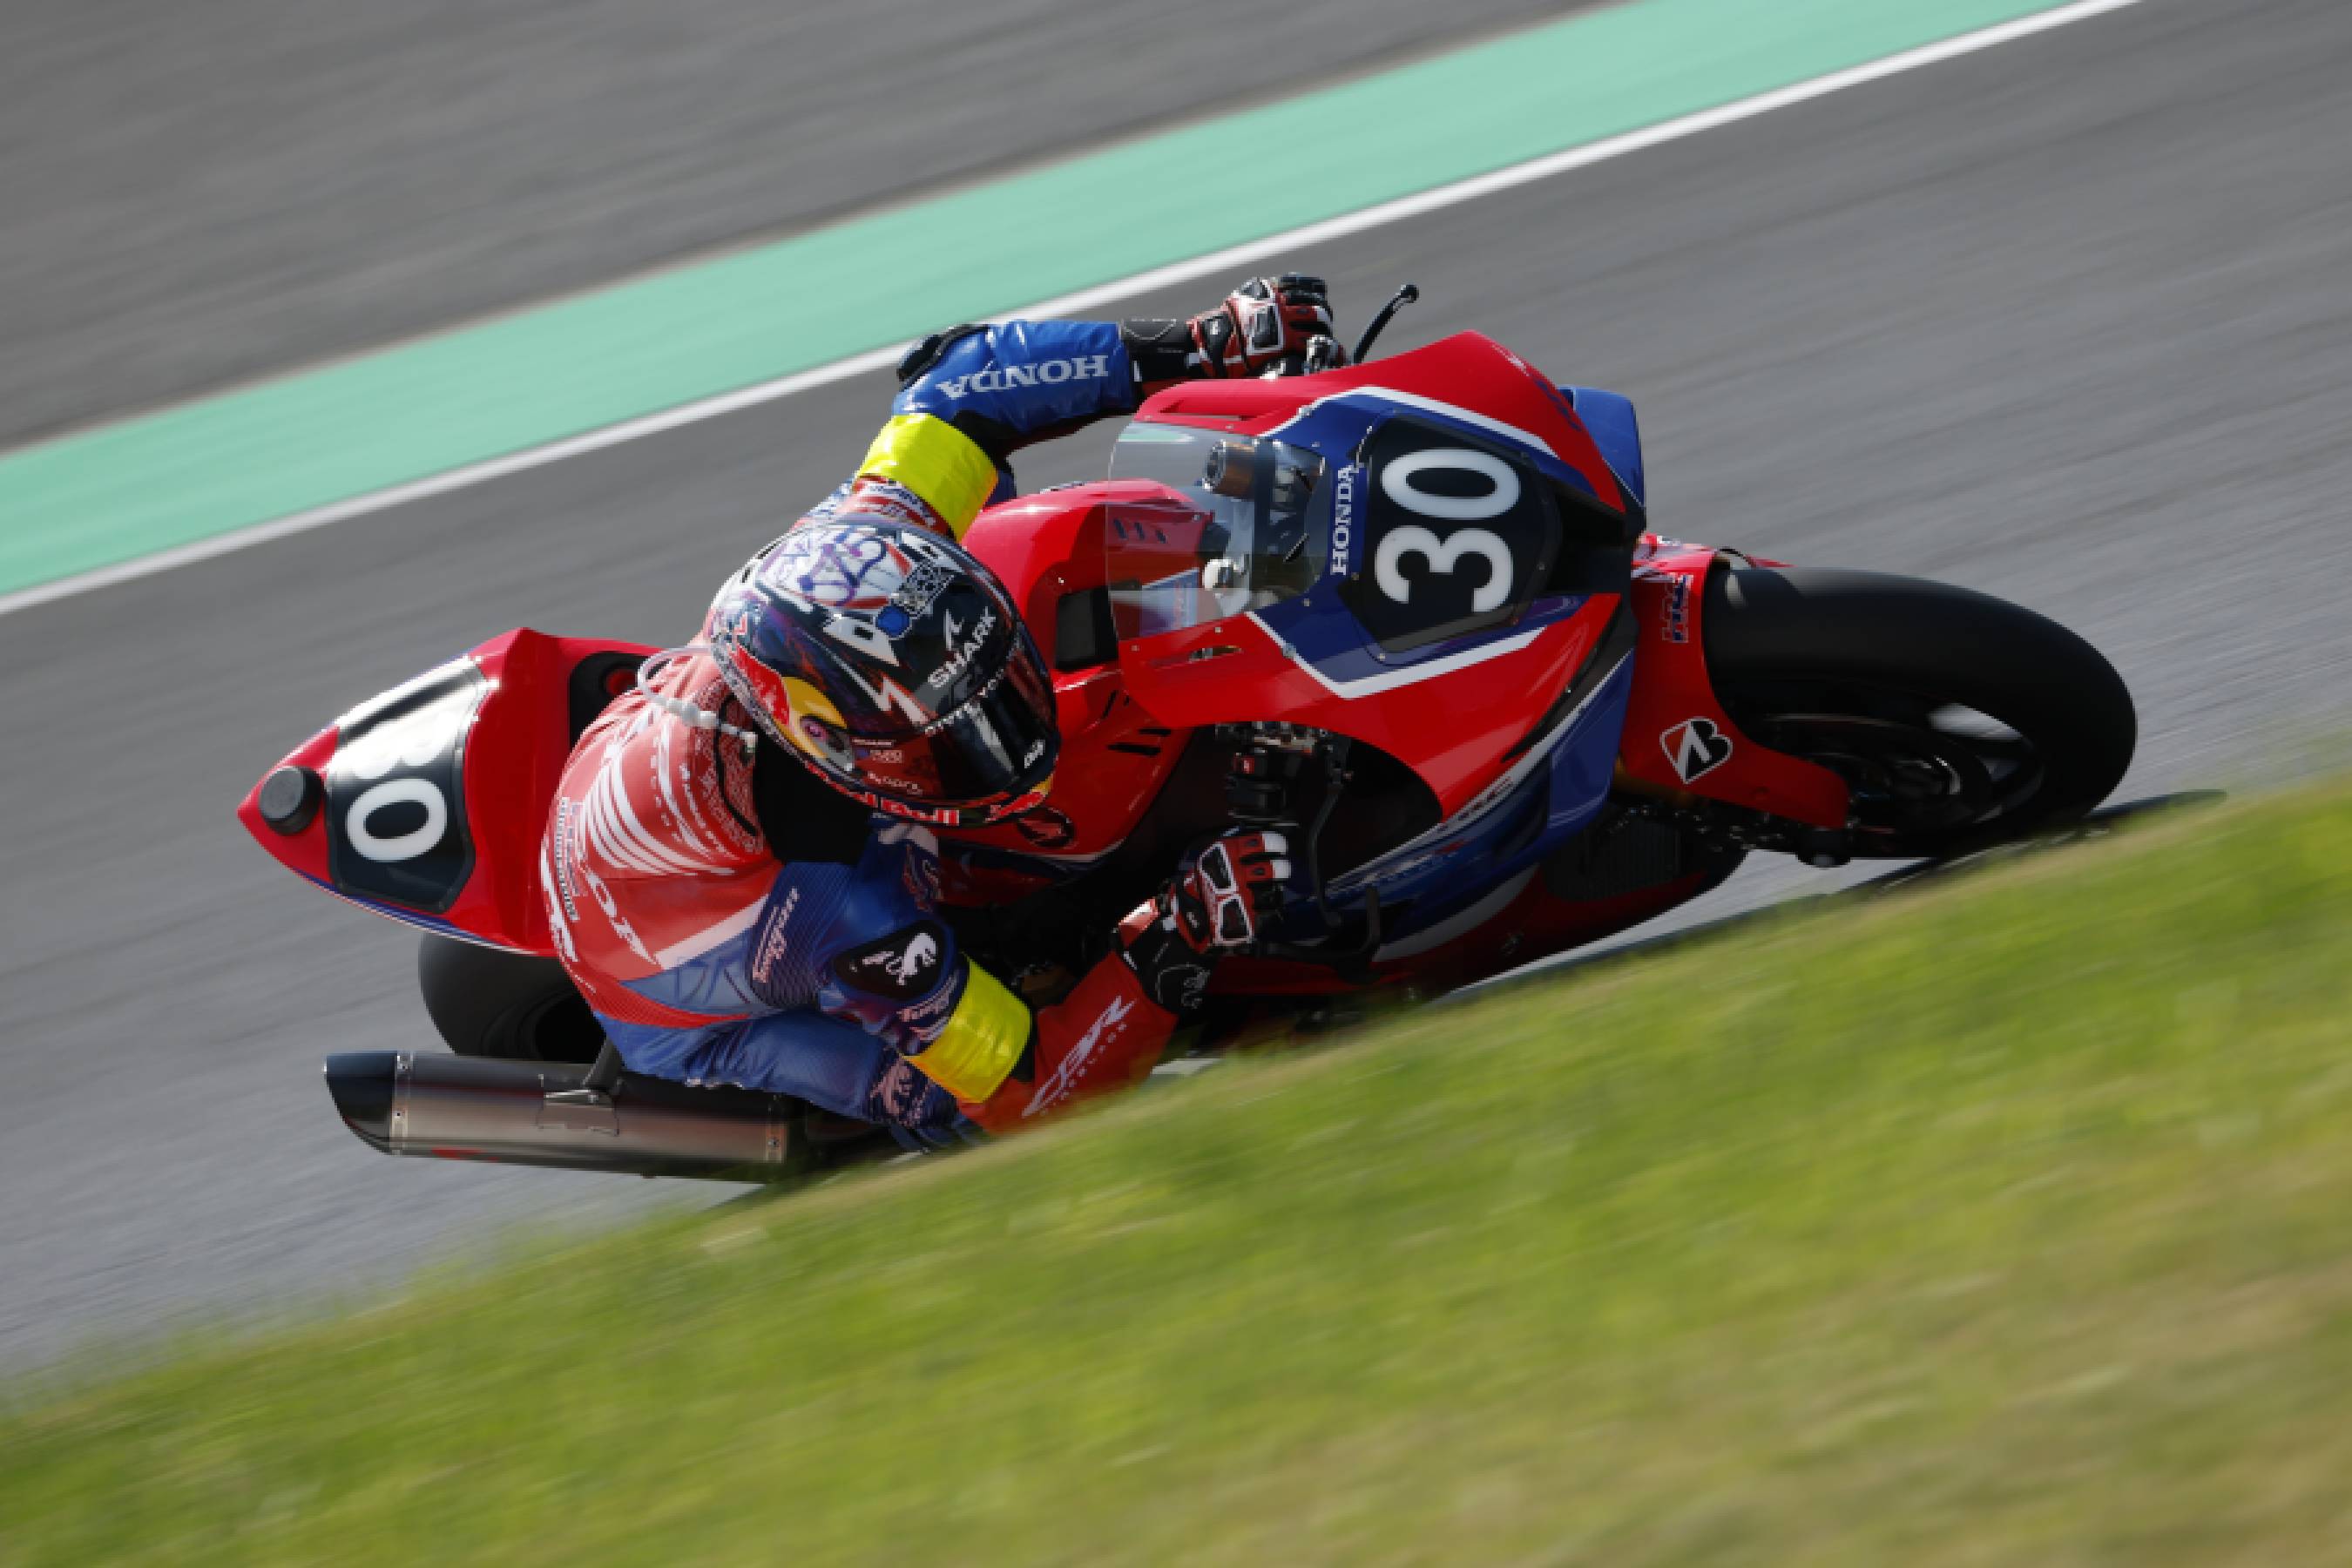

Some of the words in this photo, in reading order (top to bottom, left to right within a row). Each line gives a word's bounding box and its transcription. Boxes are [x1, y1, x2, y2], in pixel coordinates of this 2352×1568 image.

[936, 354, 1109, 401] HONDA
[1330, 463, 1356, 576] HONDA
[1374, 448, 1521, 613] 30
[926, 607, 997, 688] SHARK
